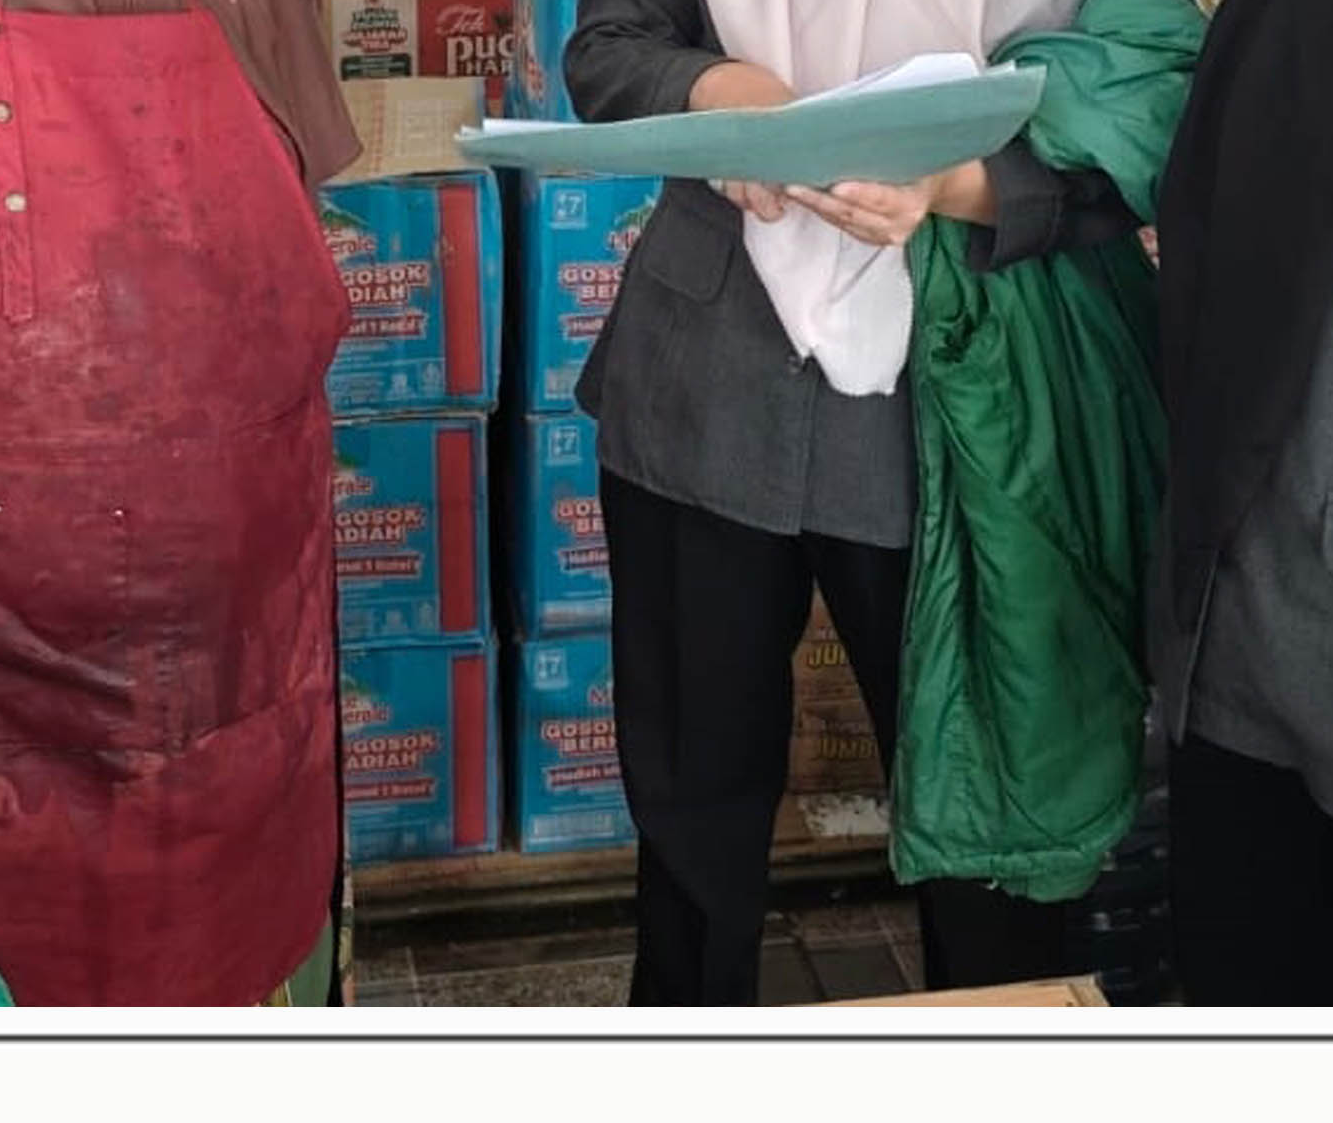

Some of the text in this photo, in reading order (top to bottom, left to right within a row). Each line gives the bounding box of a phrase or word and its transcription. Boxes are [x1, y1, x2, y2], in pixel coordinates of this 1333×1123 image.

[563, 268, 625, 282] GOSO
[559, 500, 603, 516] GOS
[546, 722, 615, 739] GOSO
[346, 752, 418, 770] ADIAH
